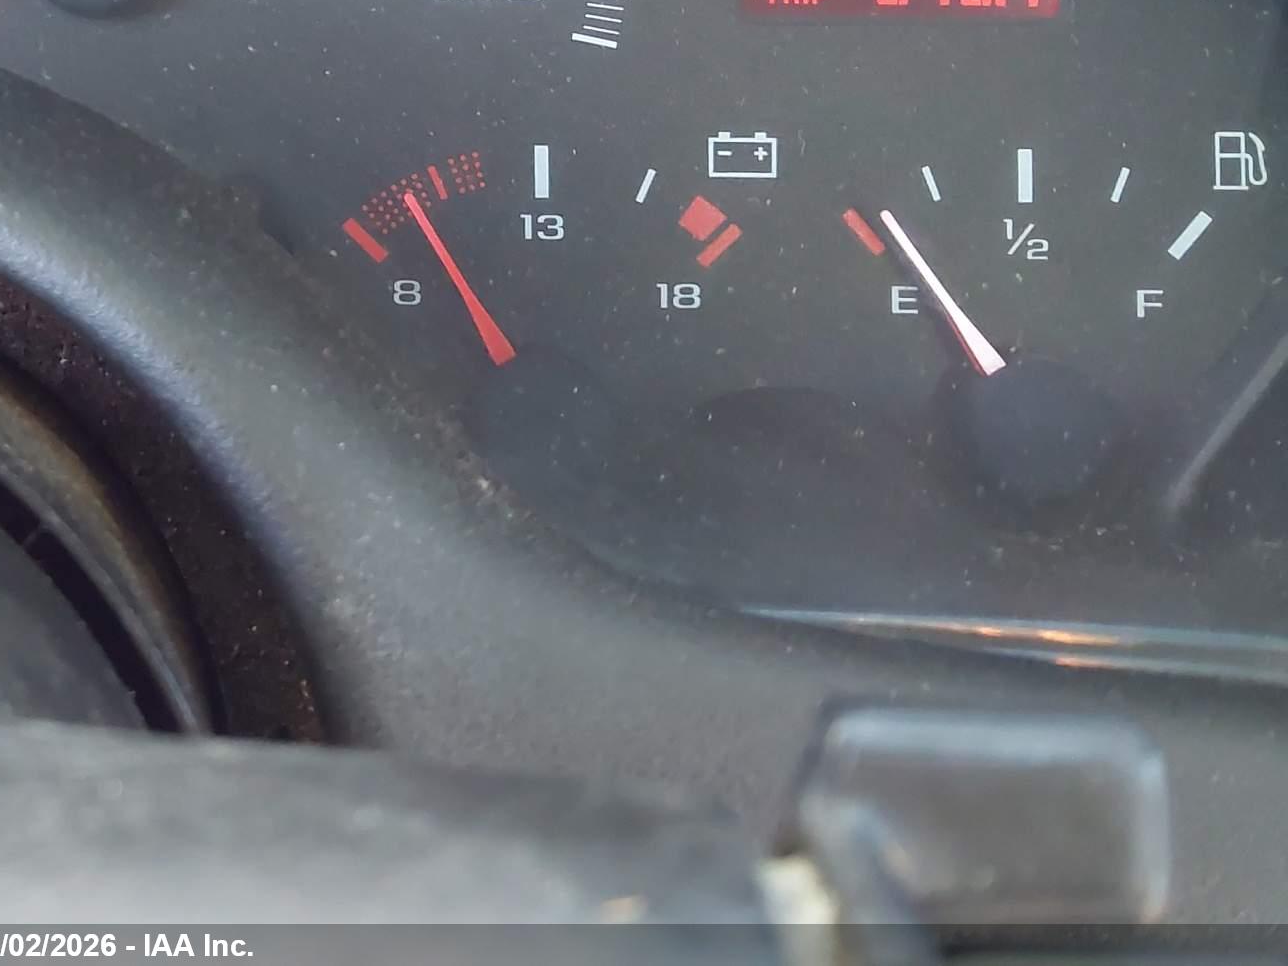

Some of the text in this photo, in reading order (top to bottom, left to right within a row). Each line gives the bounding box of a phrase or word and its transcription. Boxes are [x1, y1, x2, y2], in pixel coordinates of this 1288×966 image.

[519, 214, 565, 241] 13
[393, 280, 423, 306] 8
[655, 282, 702, 310] 18
[891, 286, 918, 314] E
[1136, 289, 1164, 318] F
